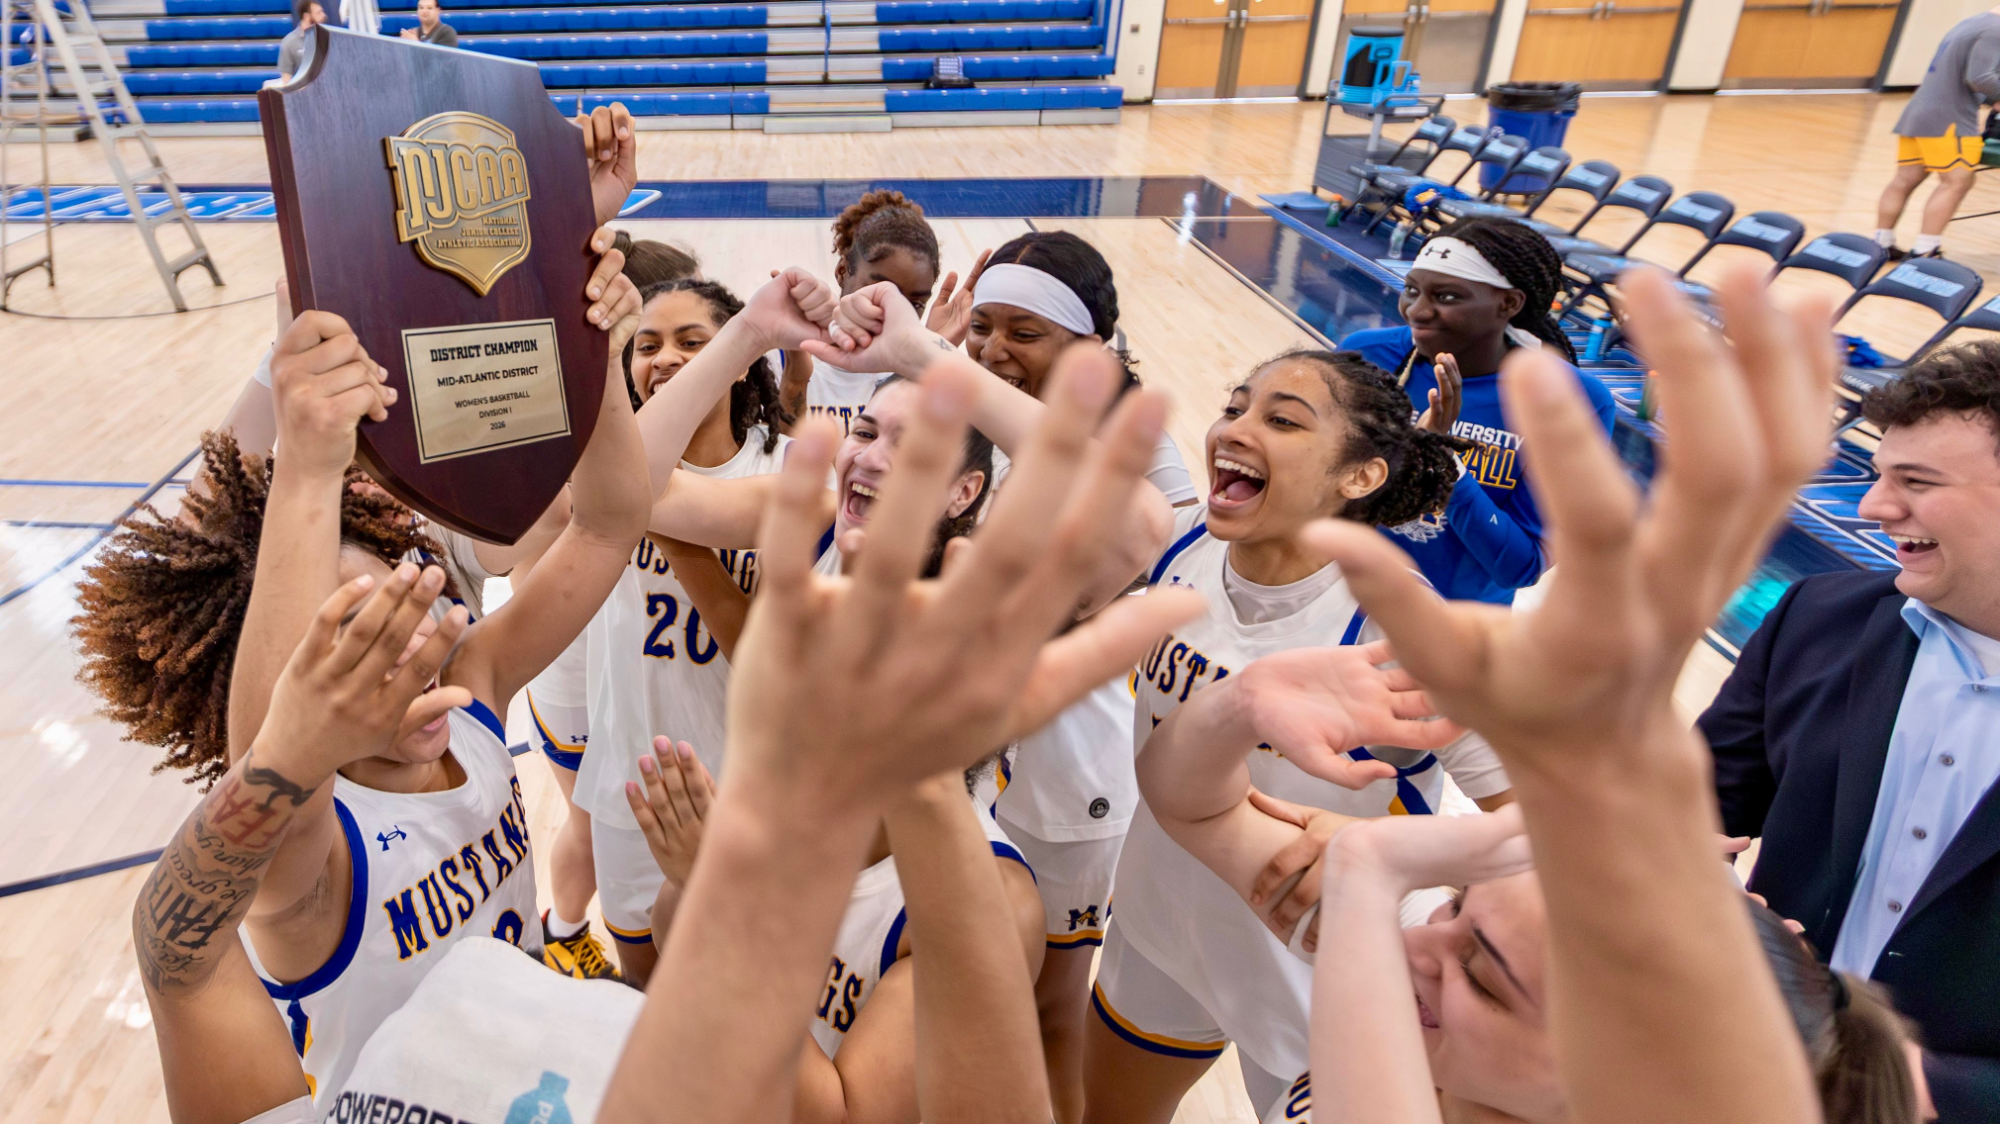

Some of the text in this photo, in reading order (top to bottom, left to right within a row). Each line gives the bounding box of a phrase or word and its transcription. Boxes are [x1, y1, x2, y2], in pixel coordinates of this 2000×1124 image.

[400, 146, 524, 229] NJCAA
[482, 216, 518, 225] NATIONAL
[461, 227, 519, 237] JUNIOR COLLEGE
[436, 238, 521, 248] ATHLETIC ASSOCIATION
[430, 339, 538, 362] DISTRICT CHAMPION
[437, 365, 539, 387] MID-ATLANTIC DISTRICT
[454, 390, 530, 409] WOMEN'S BASKETBALL
[479, 407, 508, 419] DIVISION
[490, 421, 506, 431] 2026
[1447, 420, 1524, 451] VERSITY
[642, 591, 719, 666] 20
